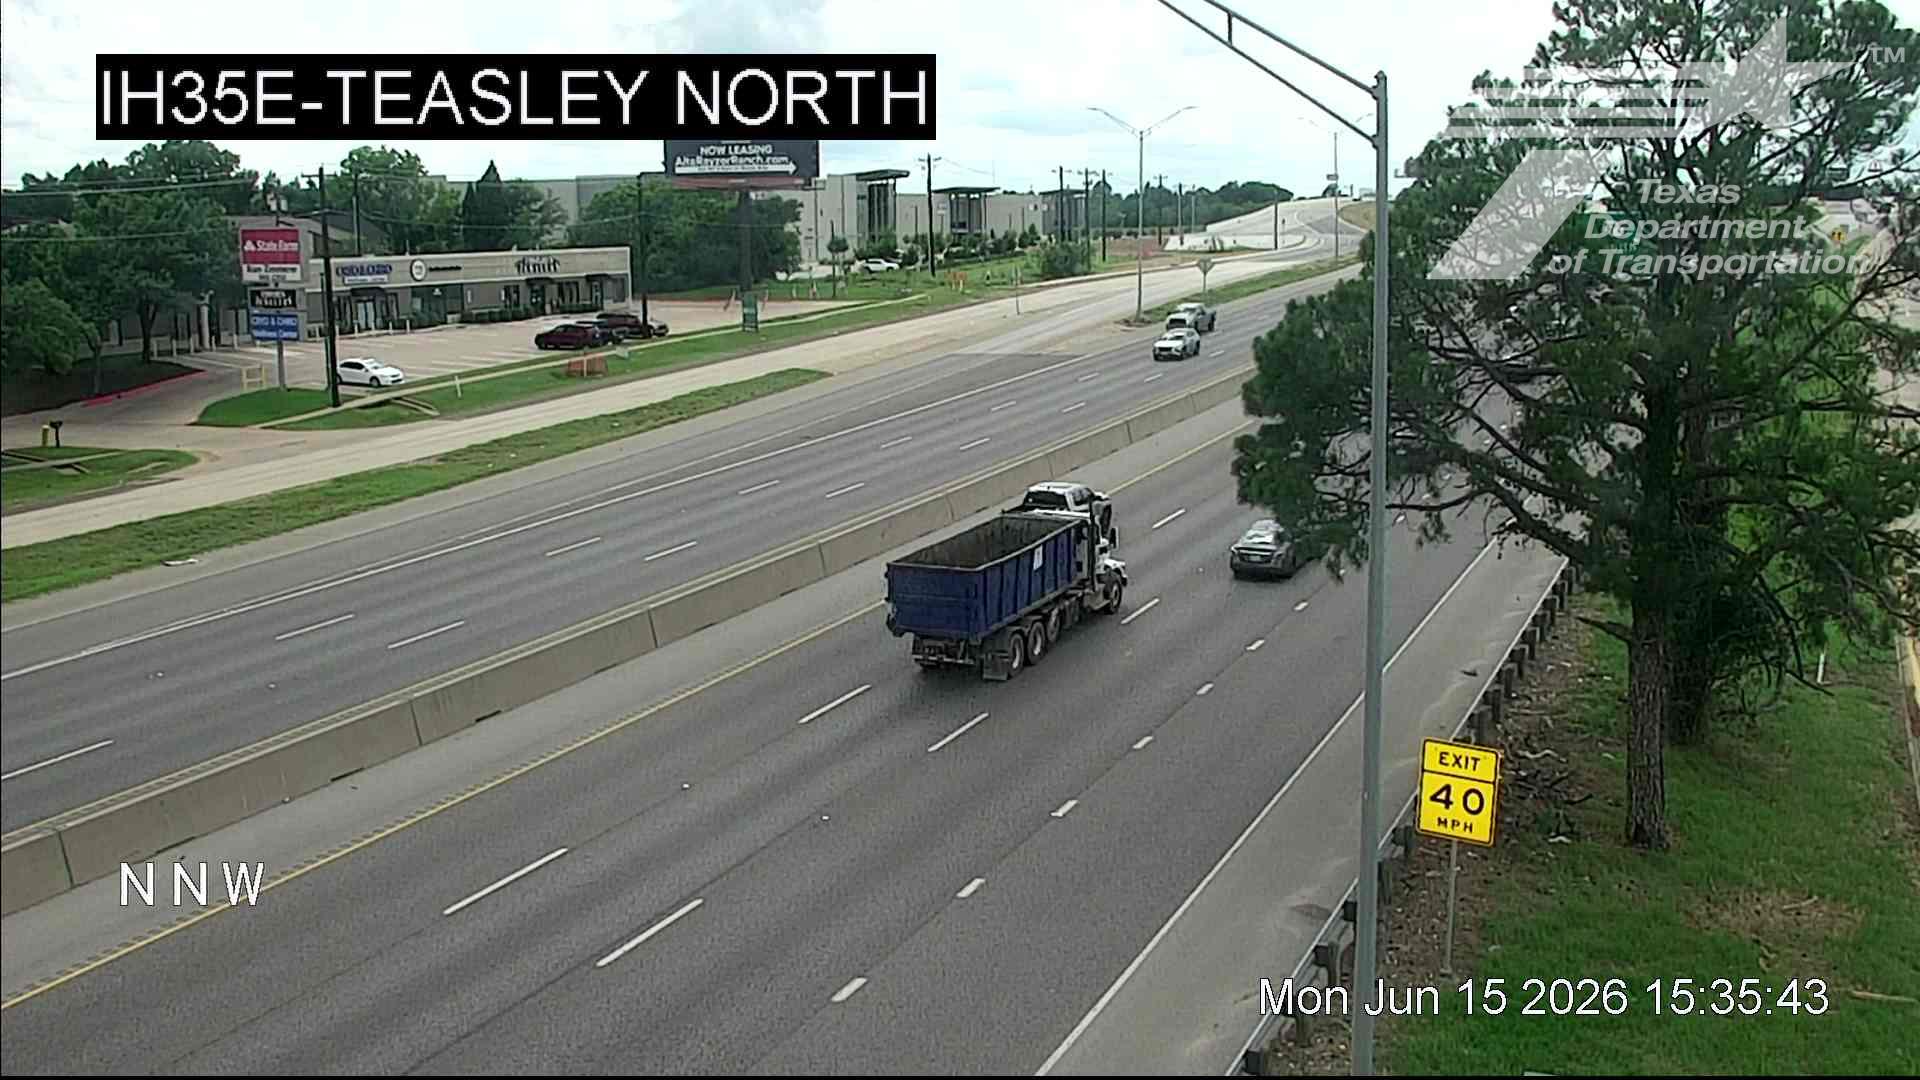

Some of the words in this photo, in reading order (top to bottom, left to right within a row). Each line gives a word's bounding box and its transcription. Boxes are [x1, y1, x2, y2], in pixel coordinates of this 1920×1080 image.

[700, 145, 726, 156] NOW
[728, 144, 773, 155] LEASING
[1439, 751, 1481, 772] EXIT
[1429, 783, 1485, 816] 40
[1436, 816, 1473, 834] MPH
